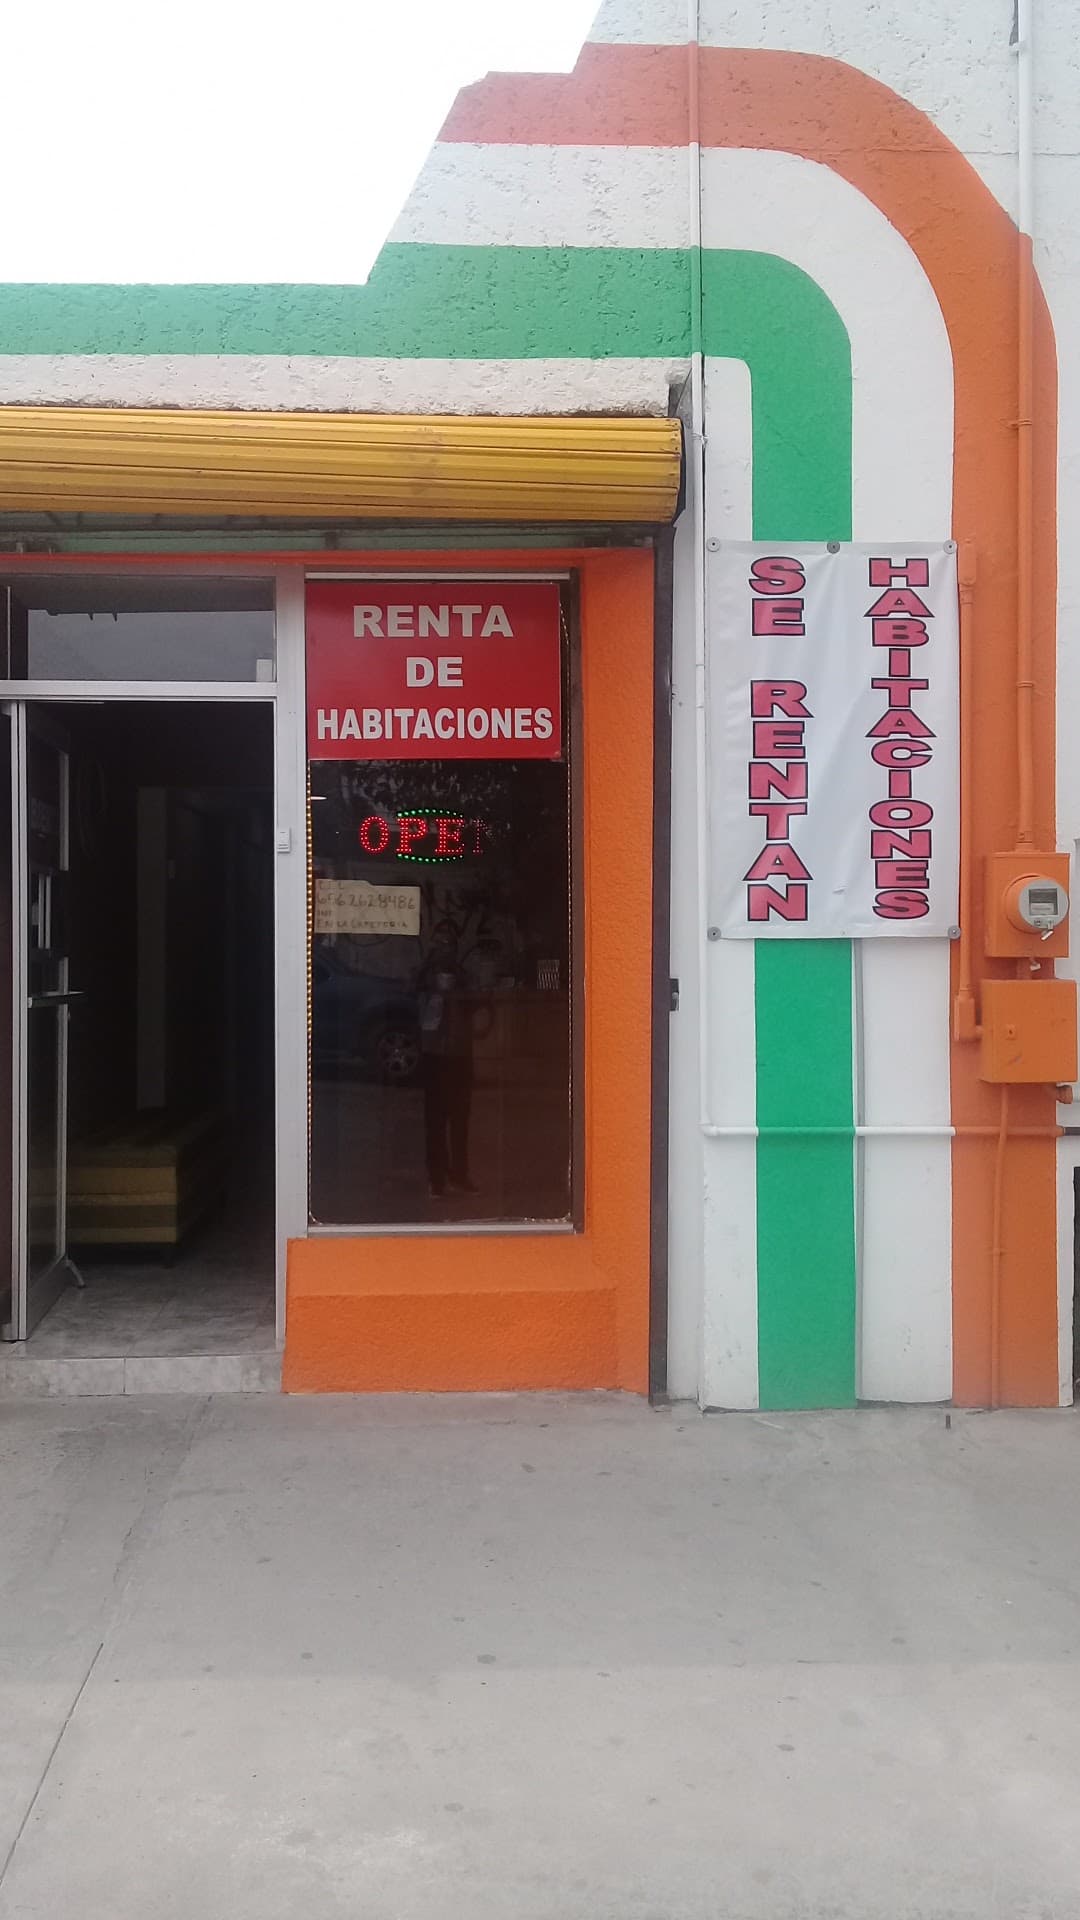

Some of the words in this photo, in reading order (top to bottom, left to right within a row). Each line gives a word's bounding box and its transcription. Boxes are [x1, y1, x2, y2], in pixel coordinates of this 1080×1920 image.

[353, 604, 514, 638] RENTA
[748, 556, 806, 637] SE
[406, 656, 464, 687] DE
[316, 707, 553, 740] HABITACIONES
[863, 557, 937, 920] HABITACIONES
[742, 680, 814, 922] RENTAN
